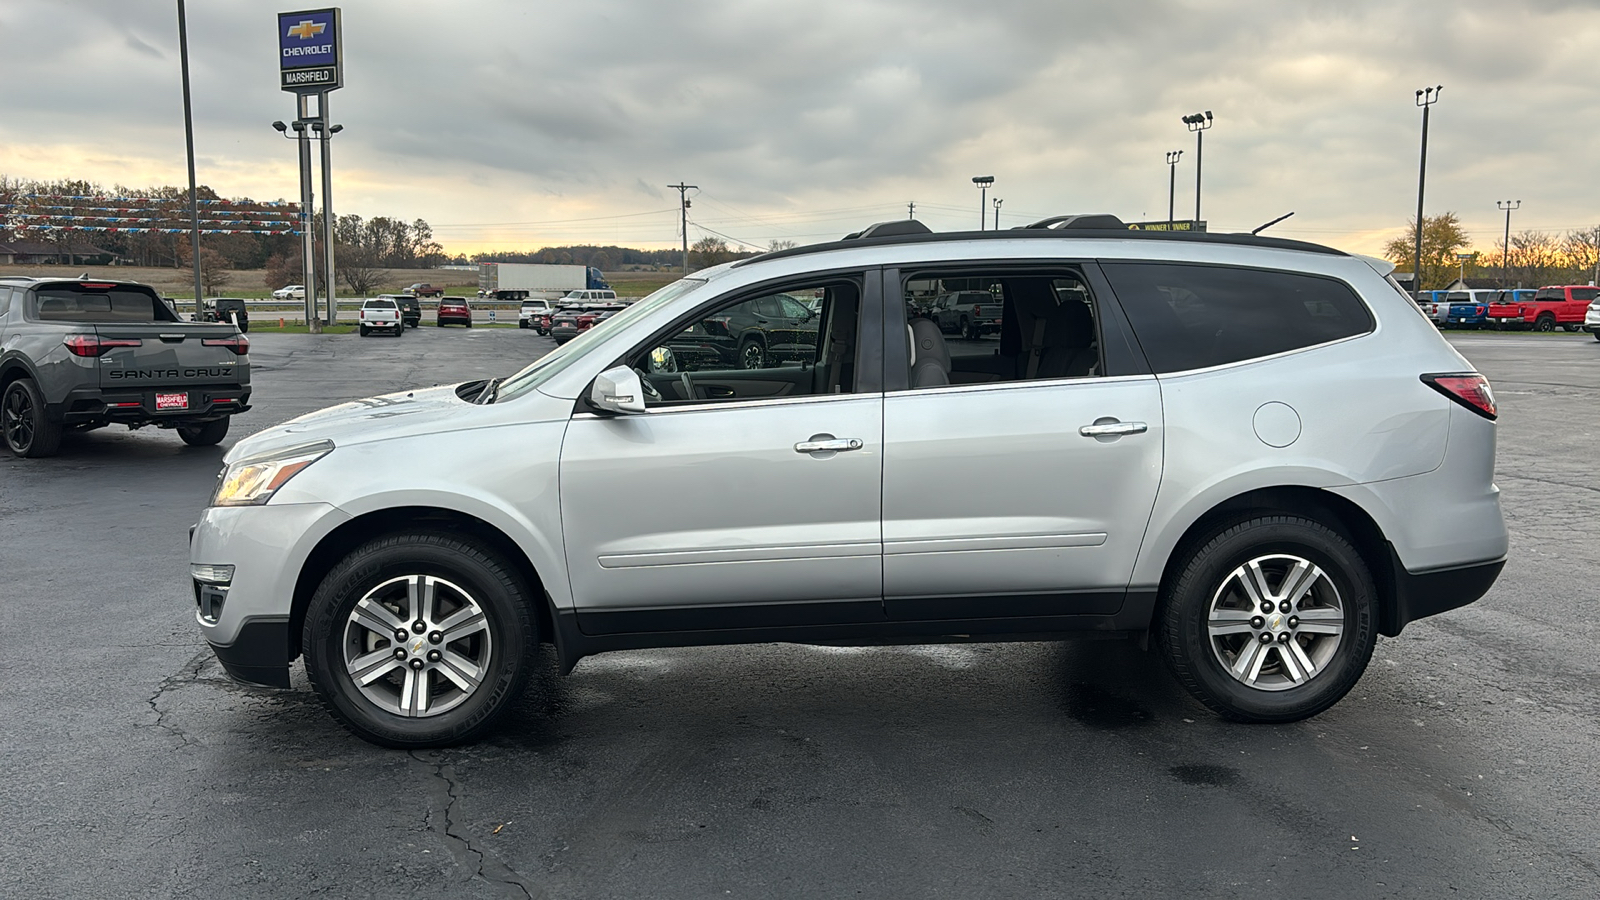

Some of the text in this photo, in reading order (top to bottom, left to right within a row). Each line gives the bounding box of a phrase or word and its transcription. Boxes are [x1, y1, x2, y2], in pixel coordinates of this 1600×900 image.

[283, 45, 332, 57] CHEVROLET
[286, 71, 329, 83] MARSHFIELD
[1145, 223, 1167, 231] WINNER
[110, 368, 232, 379] SANTA CRUZ
[157, 395, 187, 403] MARSHFIELD
[324, 561, 379, 616] MICHELIN
[452, 677, 508, 734] MICHELIN
